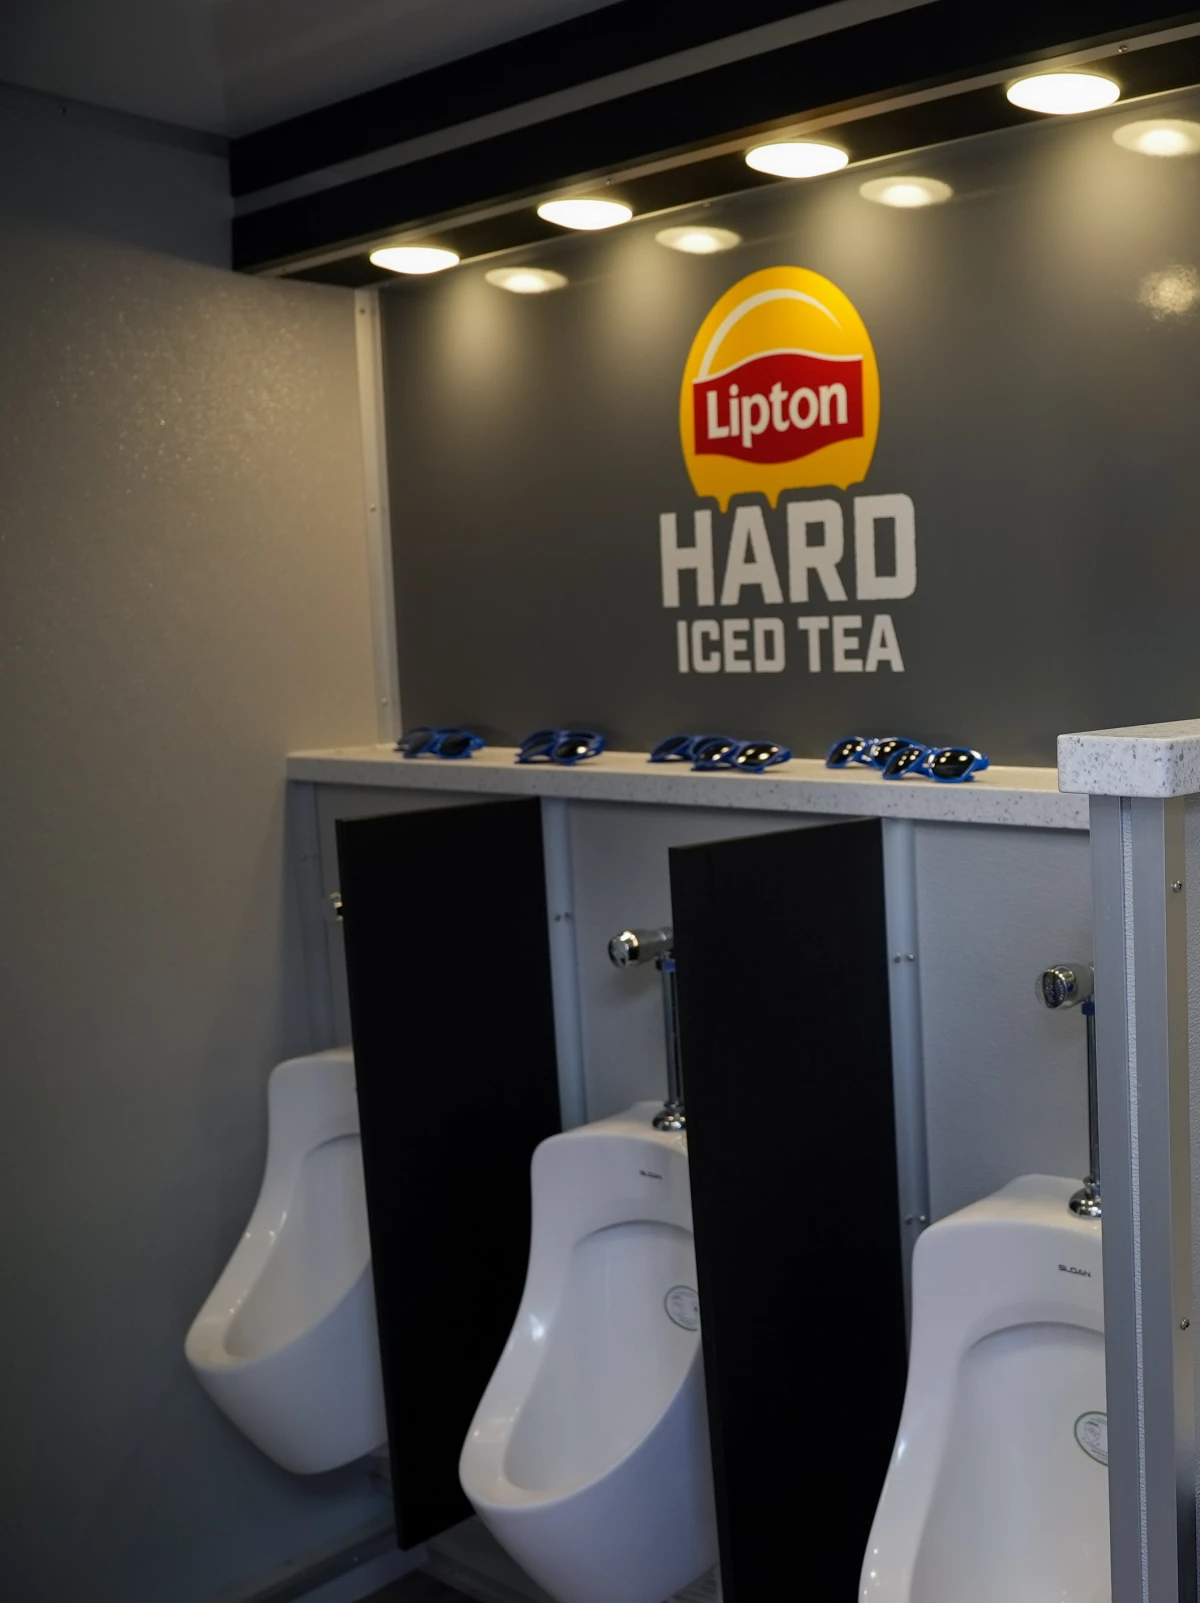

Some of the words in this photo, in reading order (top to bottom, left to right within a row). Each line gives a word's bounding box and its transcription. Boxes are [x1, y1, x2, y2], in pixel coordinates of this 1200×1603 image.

[706, 381, 849, 449] Lipton
[659, 493, 917, 608] HARD
[676, 617, 786, 674] ICED
[797, 613, 905, 673] TEA
[1058, 1264, 1092, 1278] SLOAN
